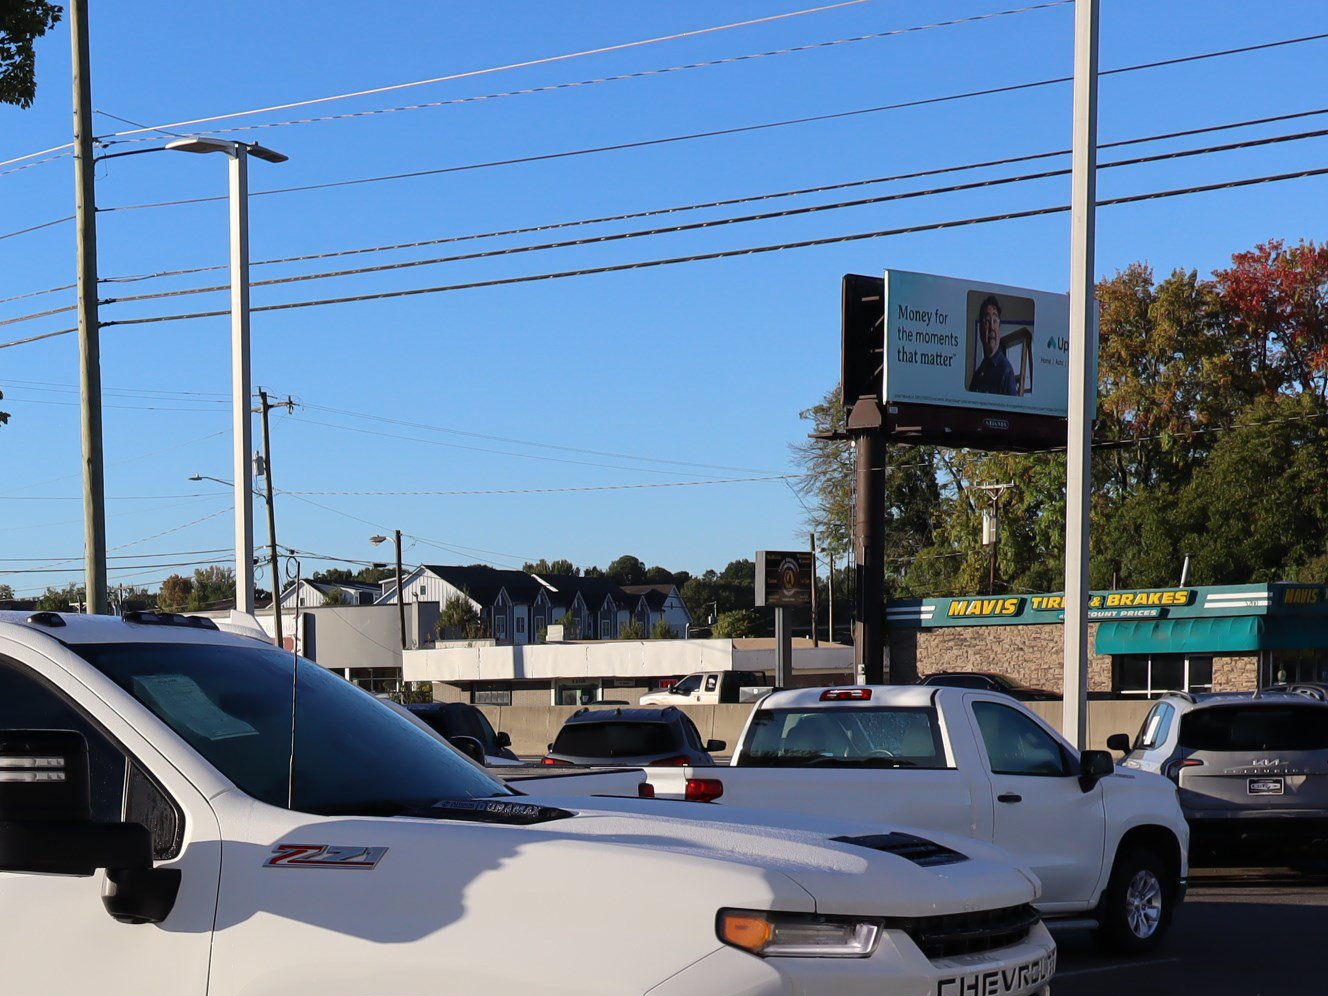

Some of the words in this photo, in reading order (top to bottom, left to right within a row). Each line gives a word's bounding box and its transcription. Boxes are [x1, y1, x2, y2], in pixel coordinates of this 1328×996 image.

[898, 304, 933, 327] Money
[935, 308, 949, 325] for
[897, 326, 913, 342] the
[915, 331, 959, 347] moments
[897, 346, 918, 364] that
[948, 598, 1019, 616] MAVIS
[1031, 596, 1065, 610] TIR
[1089, 596, 1103, 607] &
[1107, 591, 1189, 607] BRAKES
[1284, 588, 1320, 604] MAVIS
[1120, 609, 1158, 617] PRICES
[477, 801, 539, 816] DURAMAX
[264, 844, 388, 869] Z71
